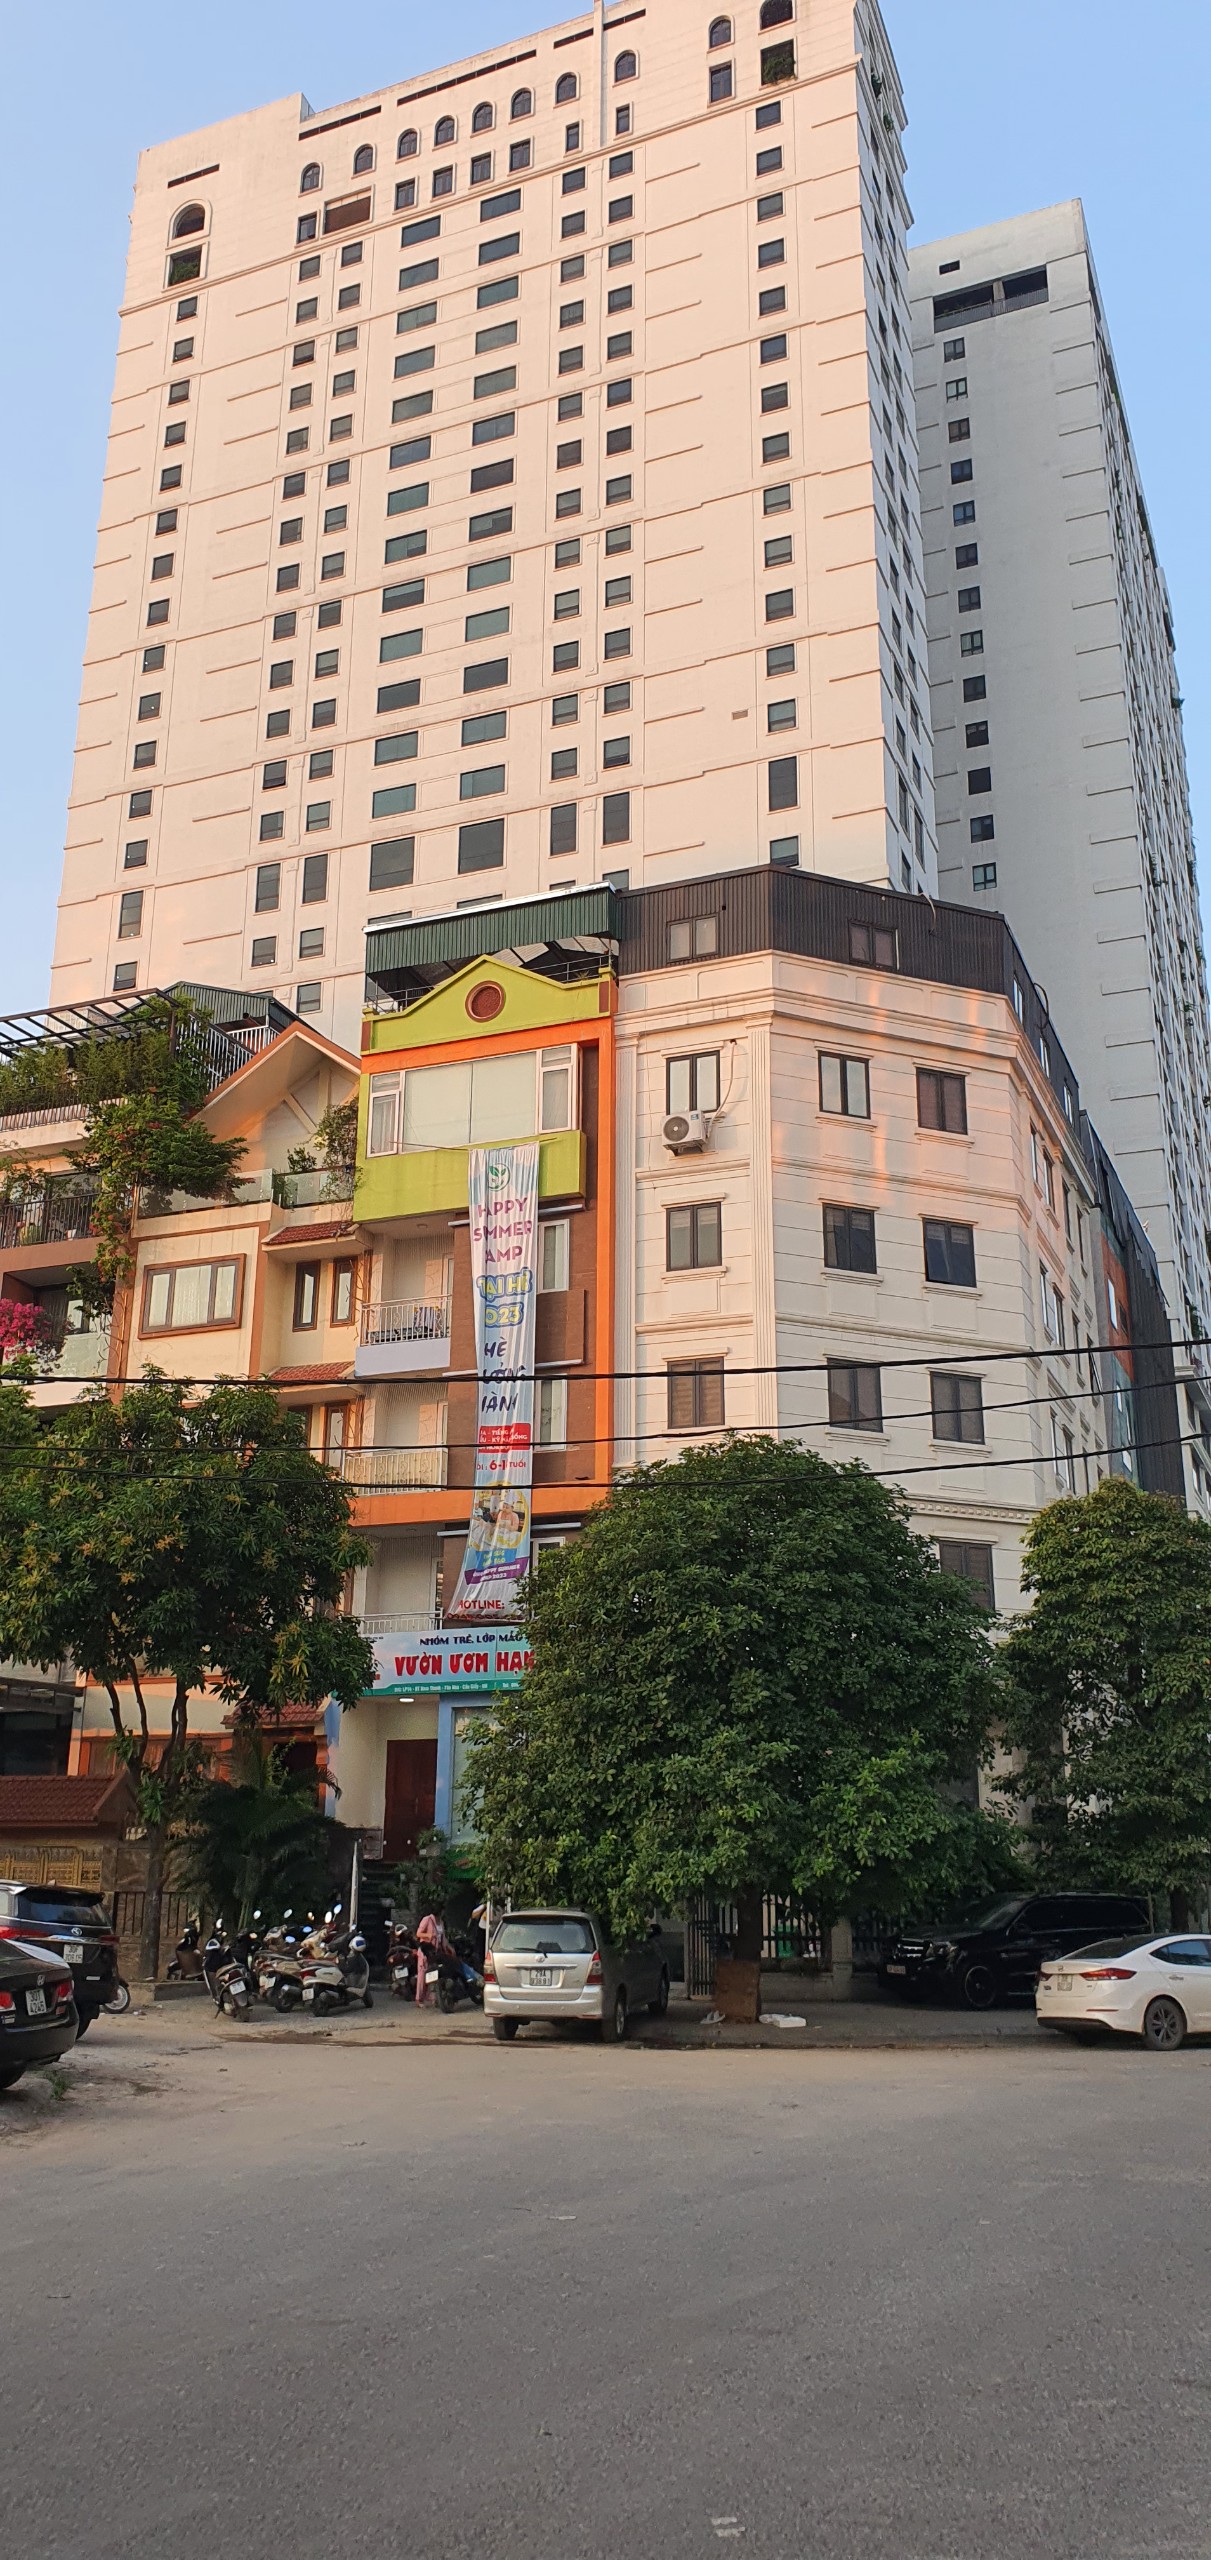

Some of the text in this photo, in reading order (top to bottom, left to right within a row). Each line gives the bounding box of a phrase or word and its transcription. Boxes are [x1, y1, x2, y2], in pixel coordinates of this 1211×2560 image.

[485, 1246, 522, 1263] AMP
[486, 1306, 520, 1324] 023
[484, 1336, 507, 1358] HÈ
[420, 1635, 449, 1646] NHÓM
[477, 1631, 496, 1644] LỚP
[395, 1651, 534, 1676] VƯỜN ƯƠM HẠN
